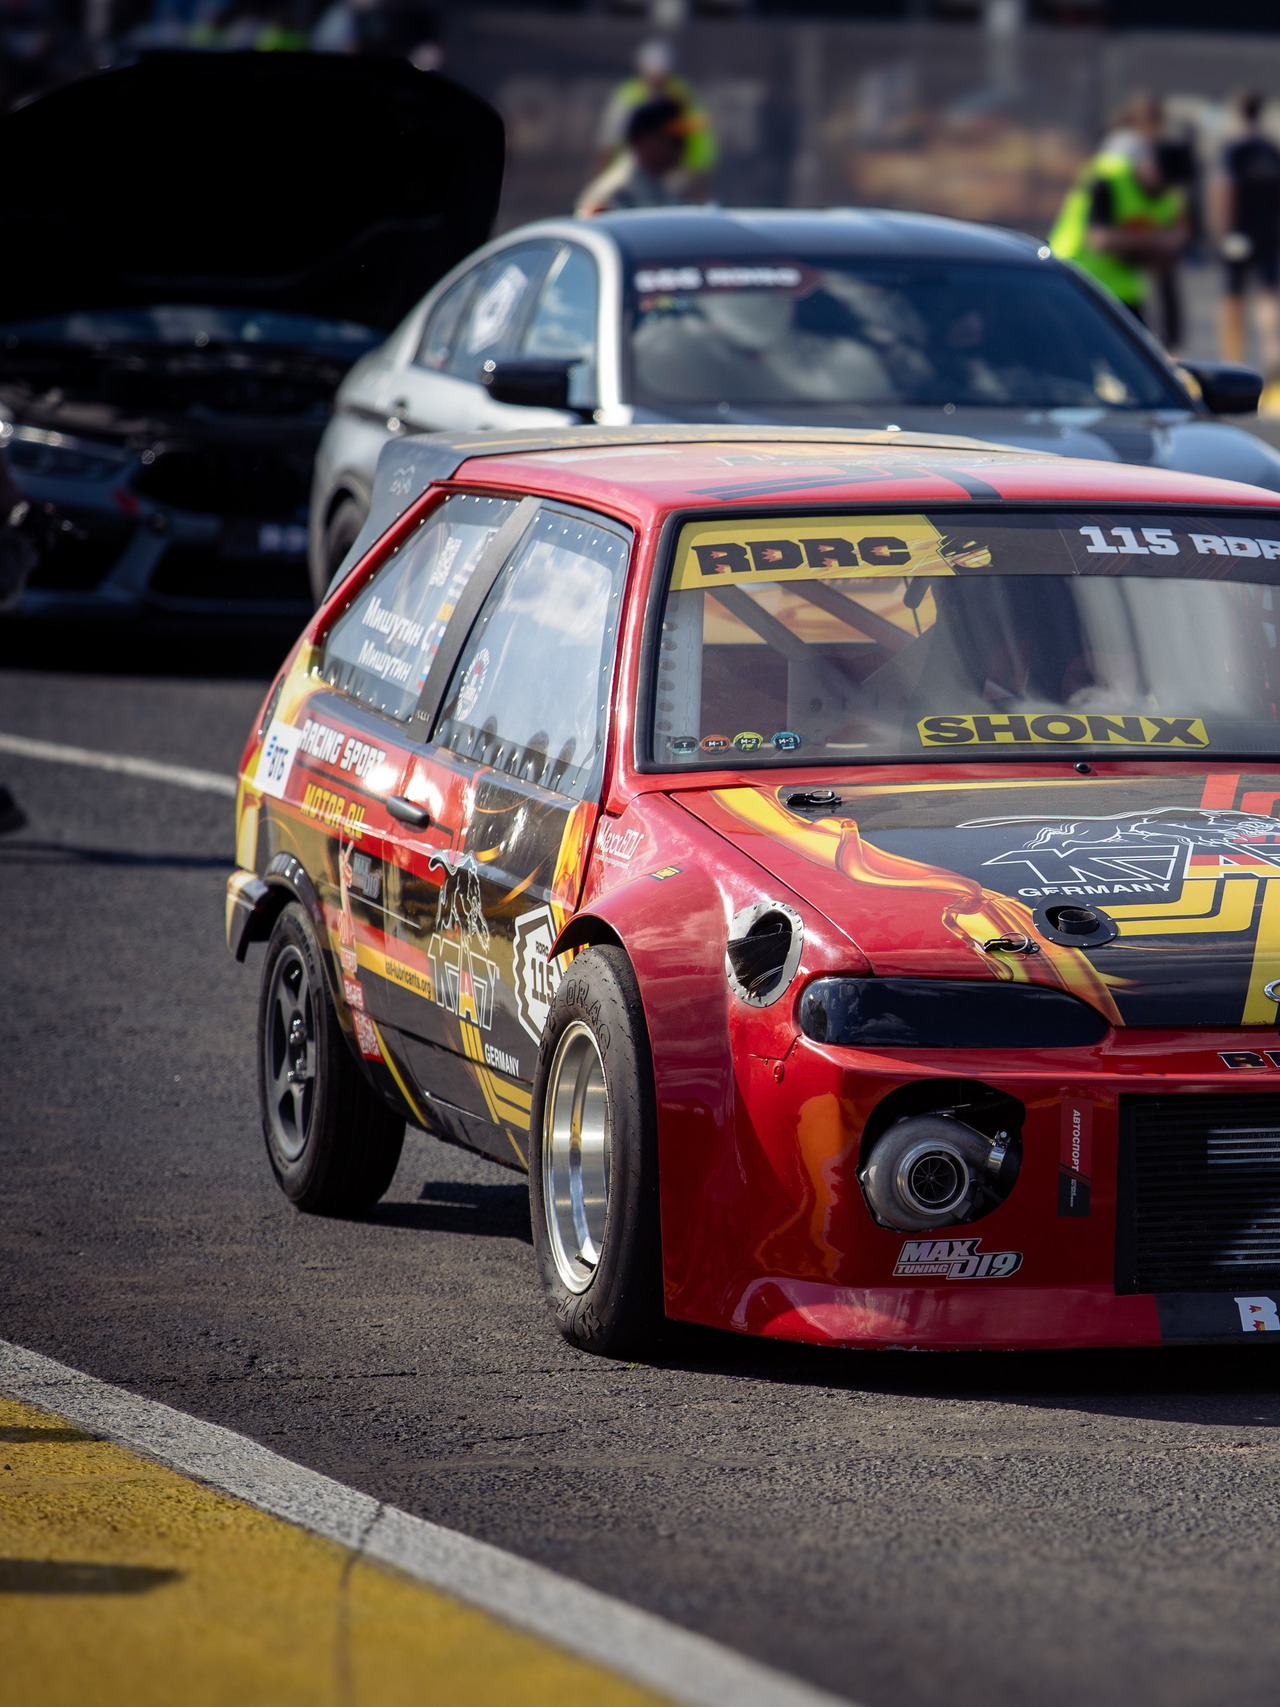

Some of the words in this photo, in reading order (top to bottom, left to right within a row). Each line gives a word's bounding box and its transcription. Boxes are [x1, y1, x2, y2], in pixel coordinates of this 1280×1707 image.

[691, 536, 912, 576] RDRC
[1078, 525, 1180, 556] 115
[362, 596, 425, 647] Мишутин
[358, 640, 413, 682] Мишутин
[300, 719, 346, 766] RACING
[339, 737, 387, 779] SPORT
[922, 715, 1203, 745] SHONX
[301, 783, 346, 830] MOTOR
[1017, 882, 1172, 897] GERMANY
[531, 958, 555, 1007] 115
[485, 1043, 520, 1078] GERMANY
[1071, 1109, 1081, 1172] АВТОСПОРТ
[897, 1264, 949, 1274] TUNING
[900, 1241, 974, 1261] MAX
